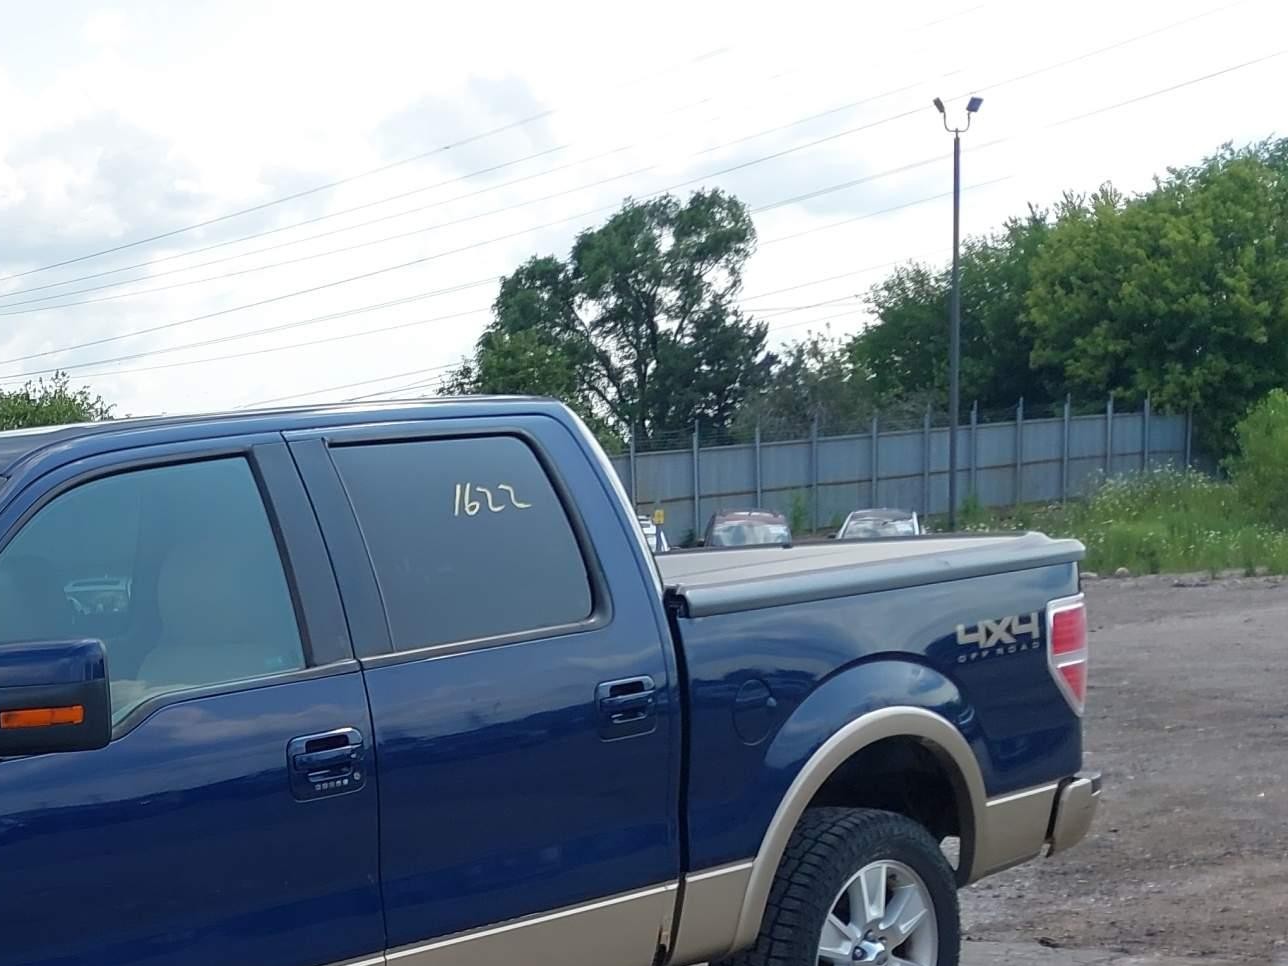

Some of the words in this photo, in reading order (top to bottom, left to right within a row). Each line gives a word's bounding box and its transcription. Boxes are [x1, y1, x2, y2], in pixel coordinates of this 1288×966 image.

[454, 482, 532, 517] 1622
[956, 651, 989, 664] OFF
[995, 641, 1041, 656] ROAD
